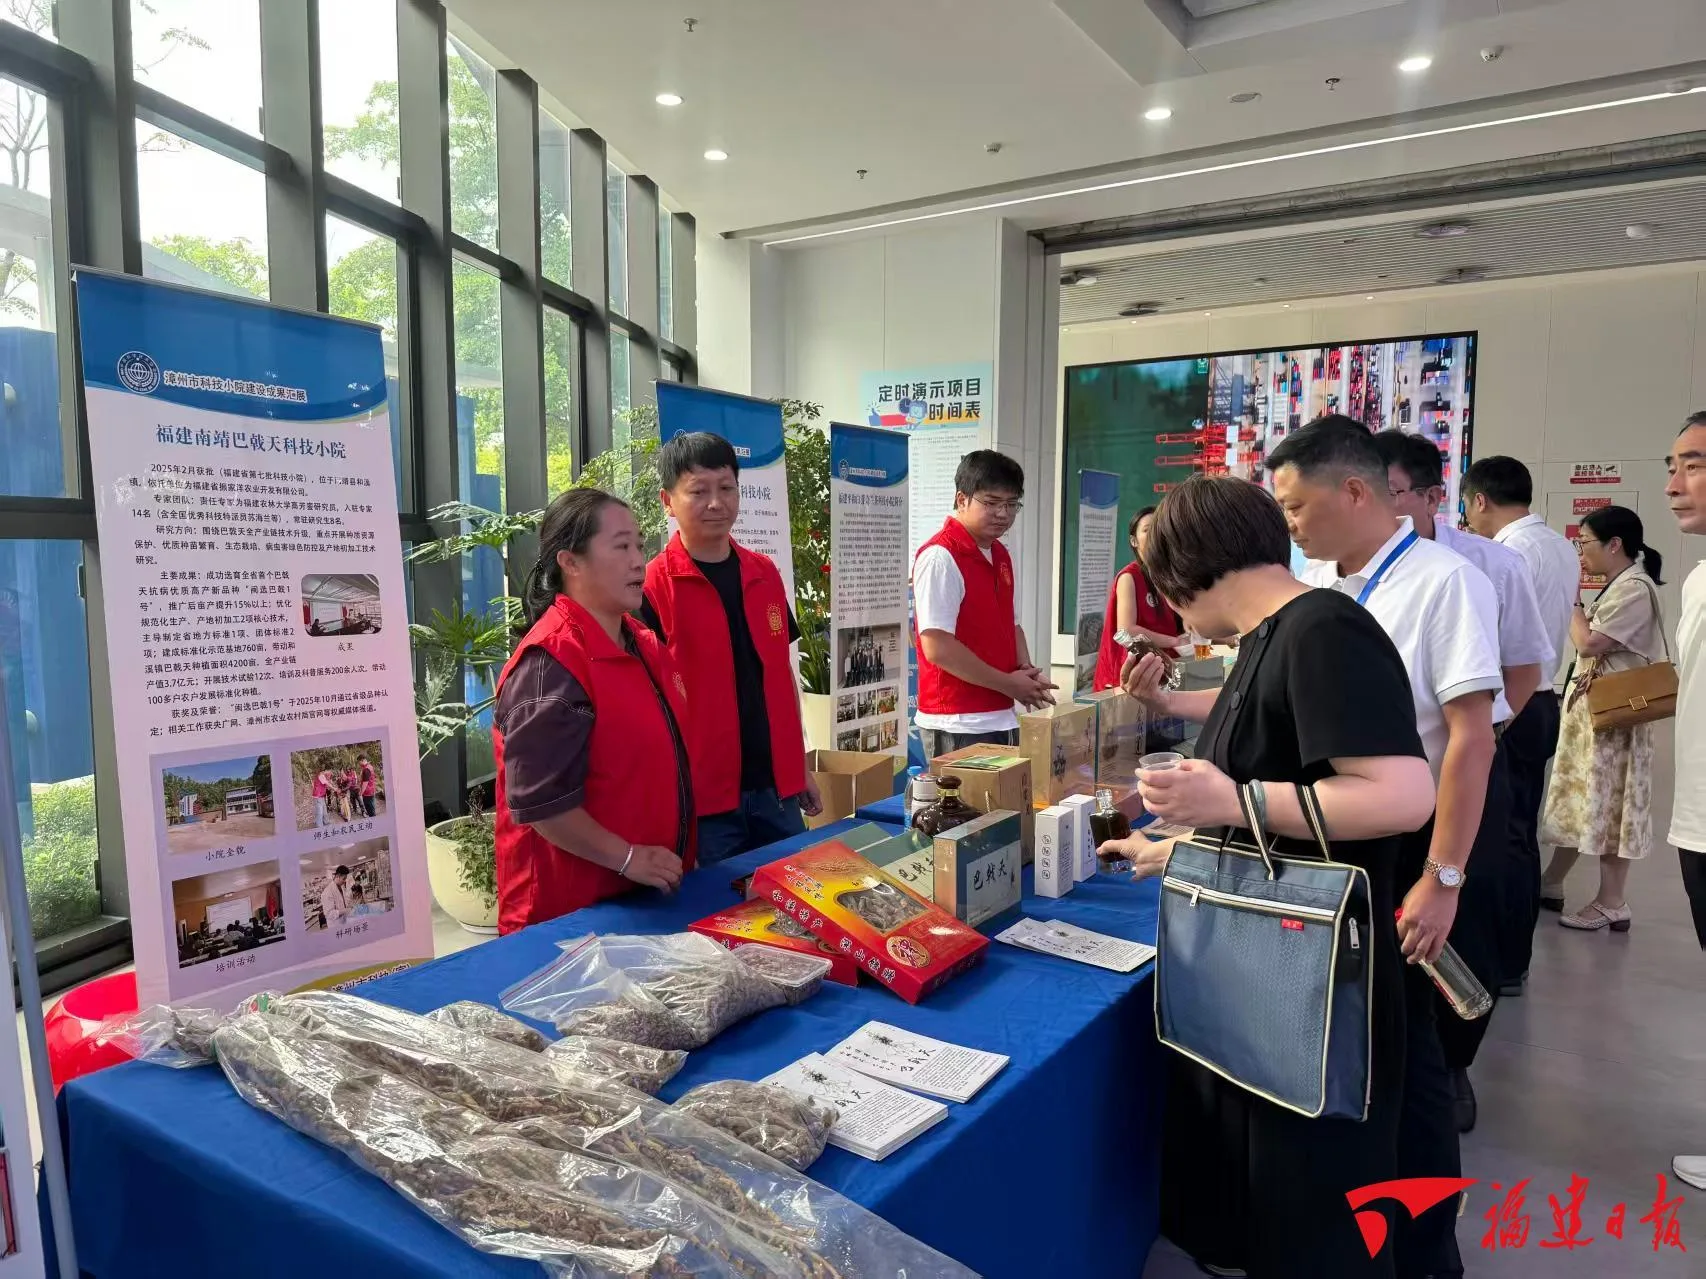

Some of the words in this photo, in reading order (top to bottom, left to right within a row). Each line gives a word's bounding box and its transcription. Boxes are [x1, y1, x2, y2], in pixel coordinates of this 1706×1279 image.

[165, 371, 307, 402] 漳州市科技小院建设成果汇展
[878, 378, 981, 403] 定时演示项目
[928, 400, 981, 421] 时间表
[156, 424, 346, 459] 福建南靖巴戟天科技小院
[740, 484, 772, 501] 科技小院
[205, 845, 247, 862] 小院全貌
[973, 858, 1007, 891] 巴戟天
